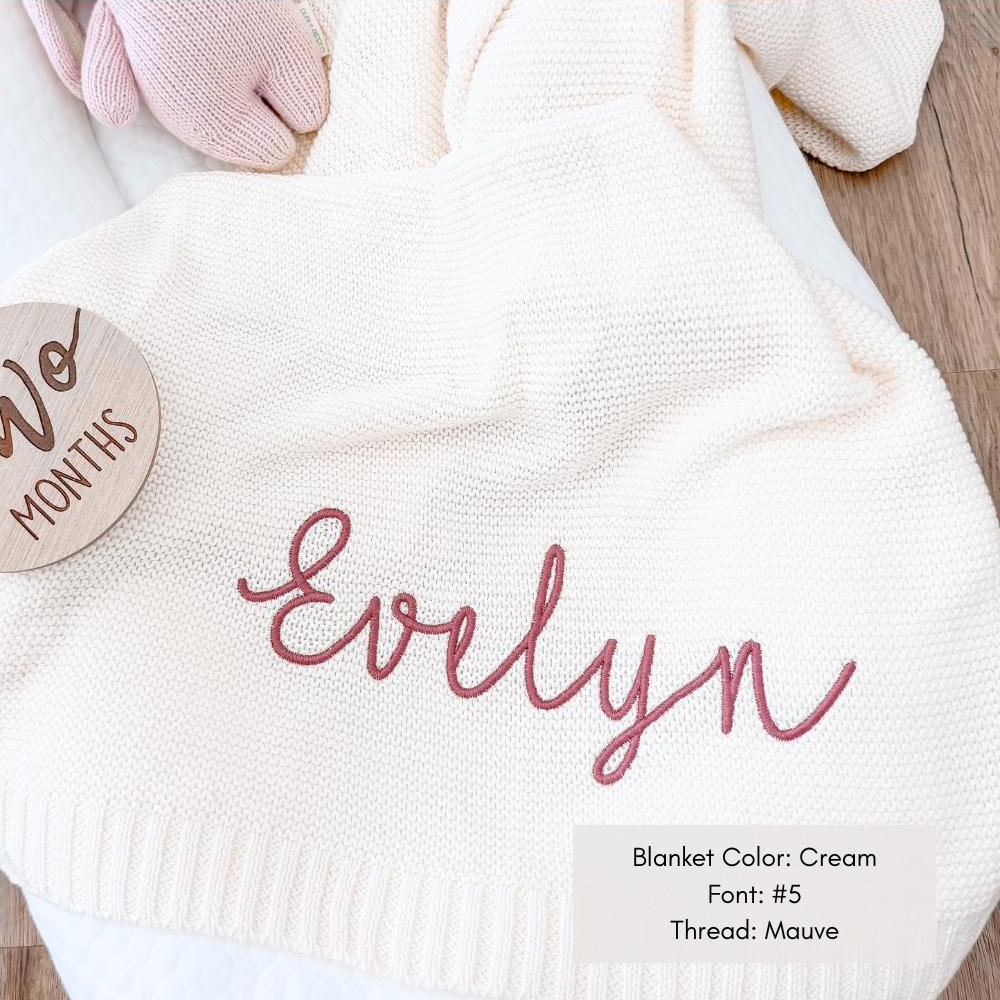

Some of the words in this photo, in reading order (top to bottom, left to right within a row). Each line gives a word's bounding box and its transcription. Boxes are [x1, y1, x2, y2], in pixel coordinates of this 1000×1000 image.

[0, 307, 81, 458] wo
[10, 408, 138, 541] MONTHS
[237, 507, 857, 785] Evelyn
